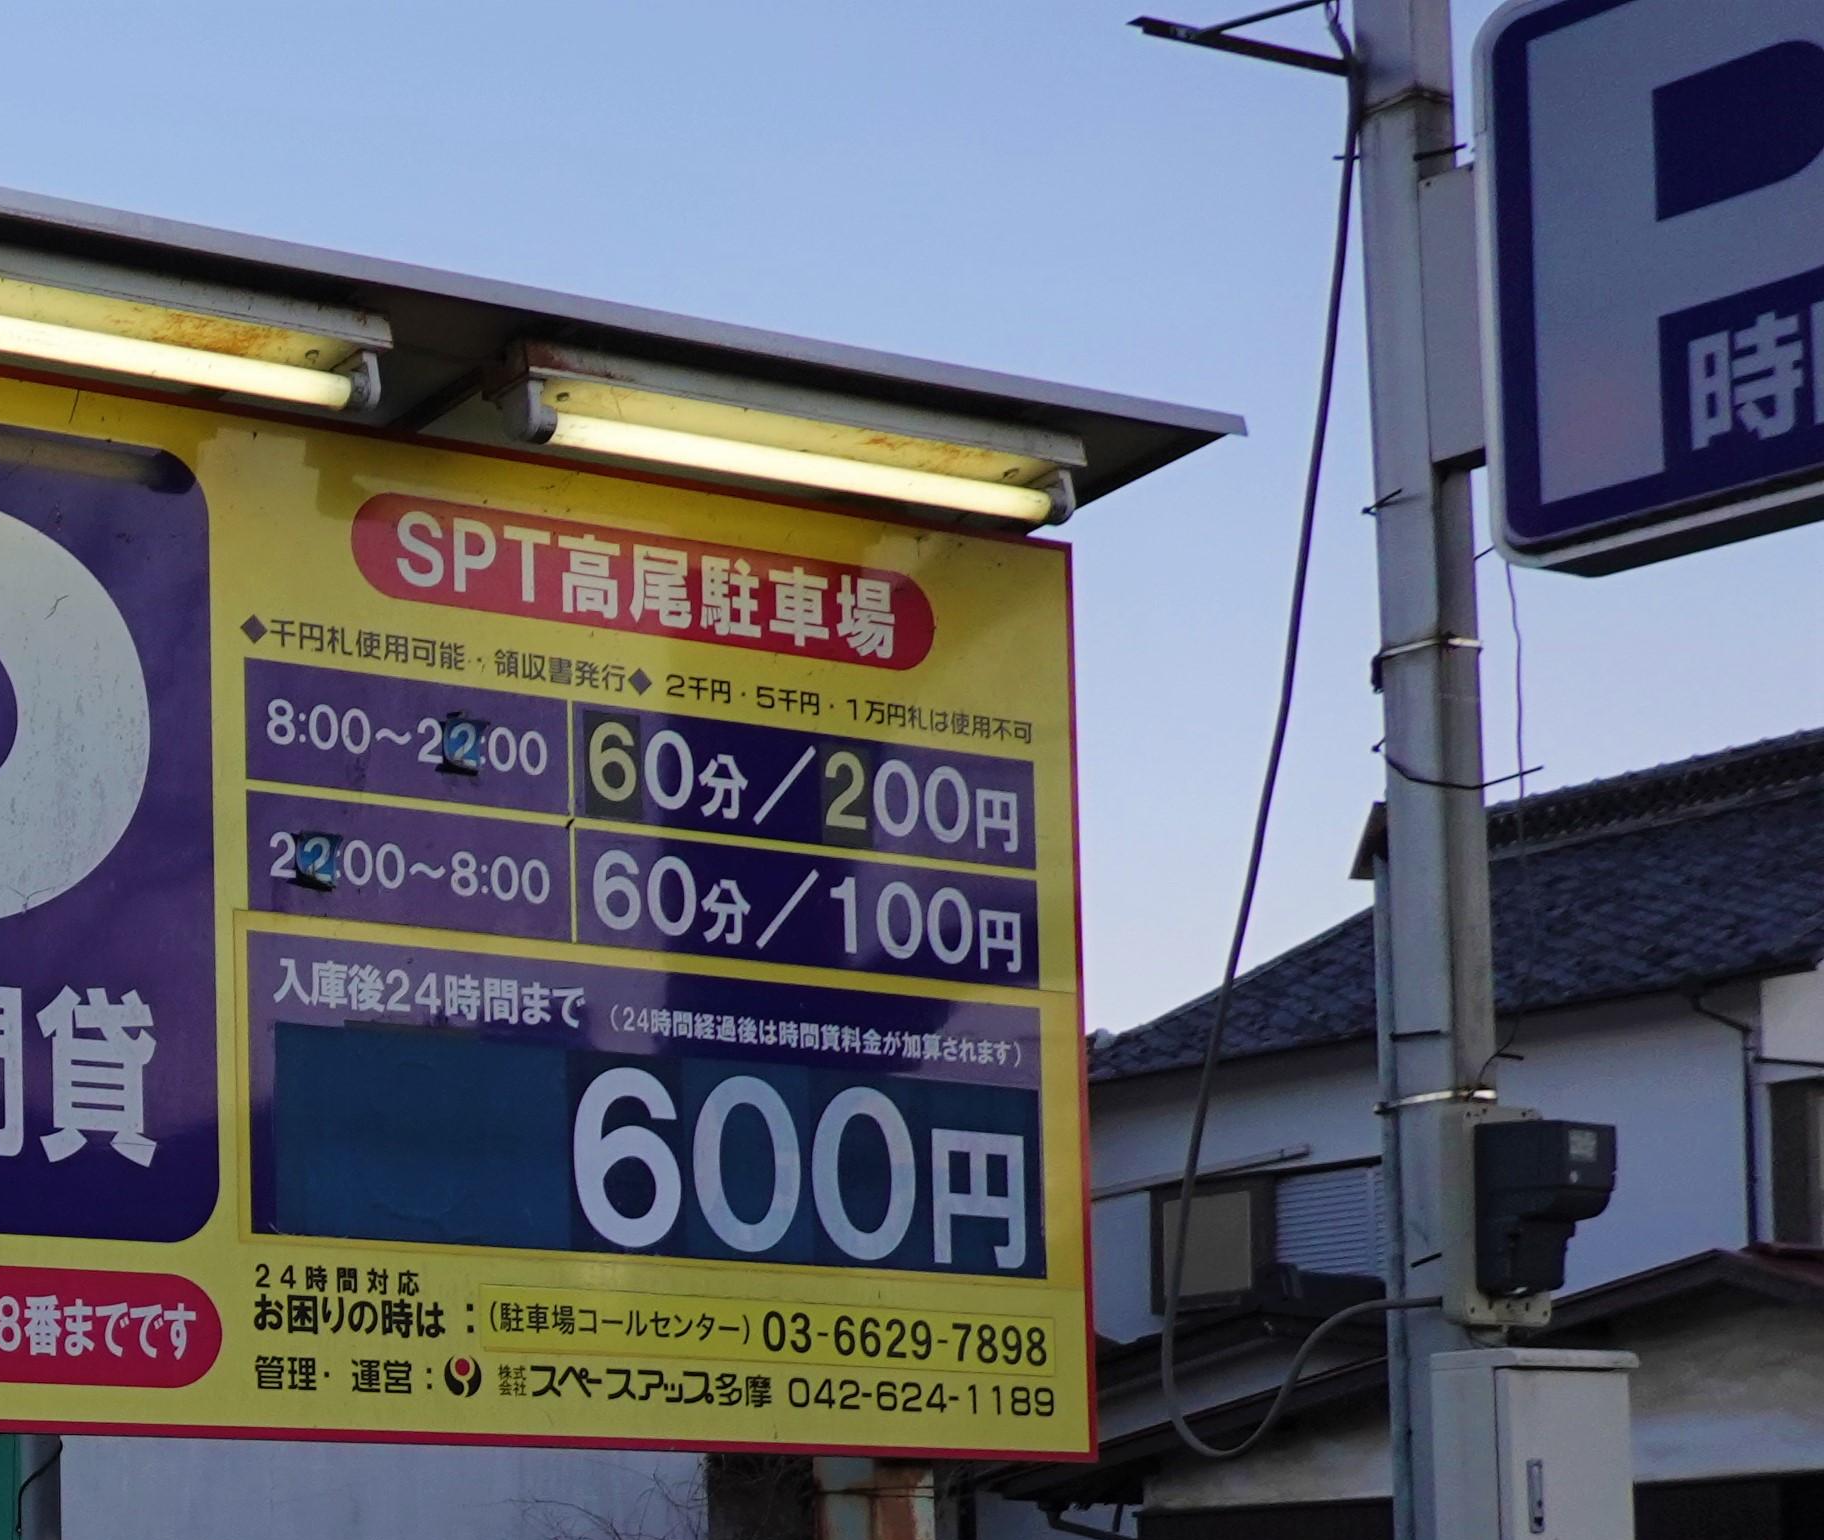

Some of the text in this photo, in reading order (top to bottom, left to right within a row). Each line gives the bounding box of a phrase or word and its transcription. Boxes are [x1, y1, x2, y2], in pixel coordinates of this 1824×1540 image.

[396, 510, 895, 660] SPT高尾駐車場
[273, 957, 587, 1030] 入庫後24時間まで
[573, 1066, 1028, 1270] 600円
[762, 1310, 1048, 1367] 03-6629-7898
[788, 1376, 1055, 1418] 042-624-1189
